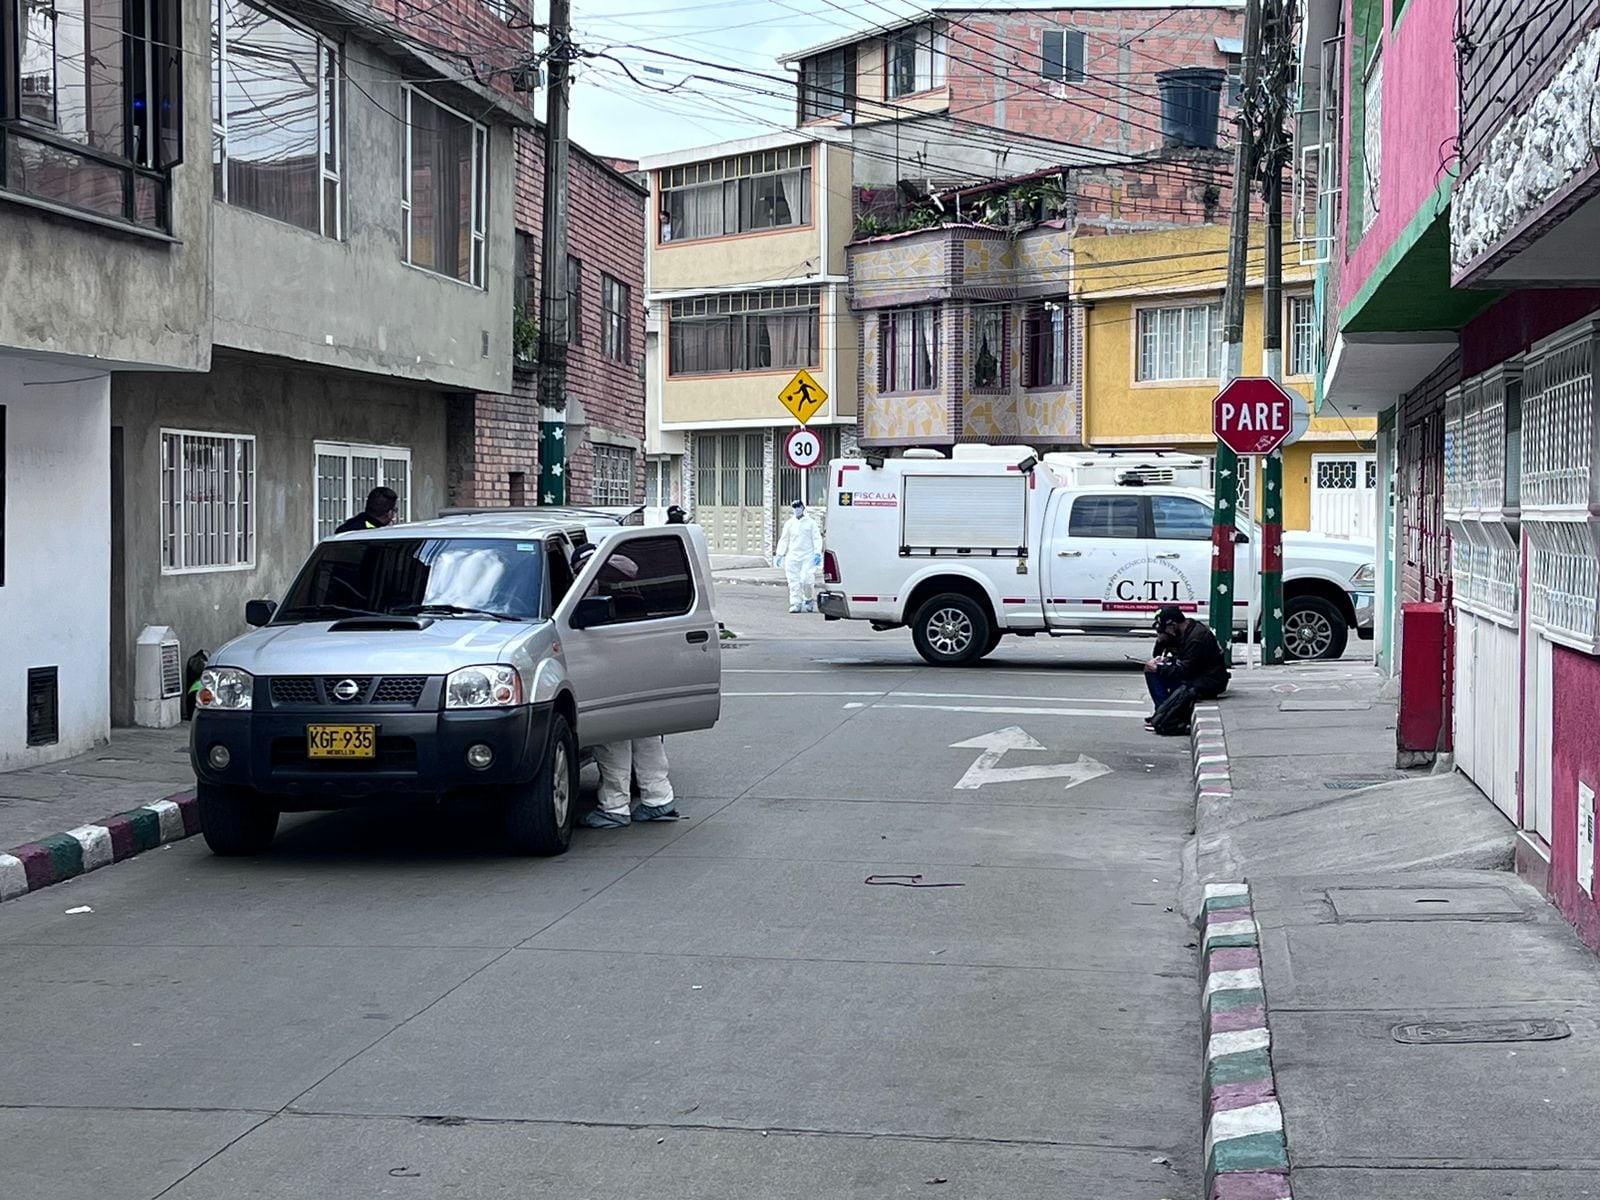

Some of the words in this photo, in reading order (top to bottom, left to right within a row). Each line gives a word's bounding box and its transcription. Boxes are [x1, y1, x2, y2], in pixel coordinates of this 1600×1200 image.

[1222, 402, 1284, 431] PARE
[795, 442, 812, 456] 30
[1116, 580, 1180, 601] C.T.I
